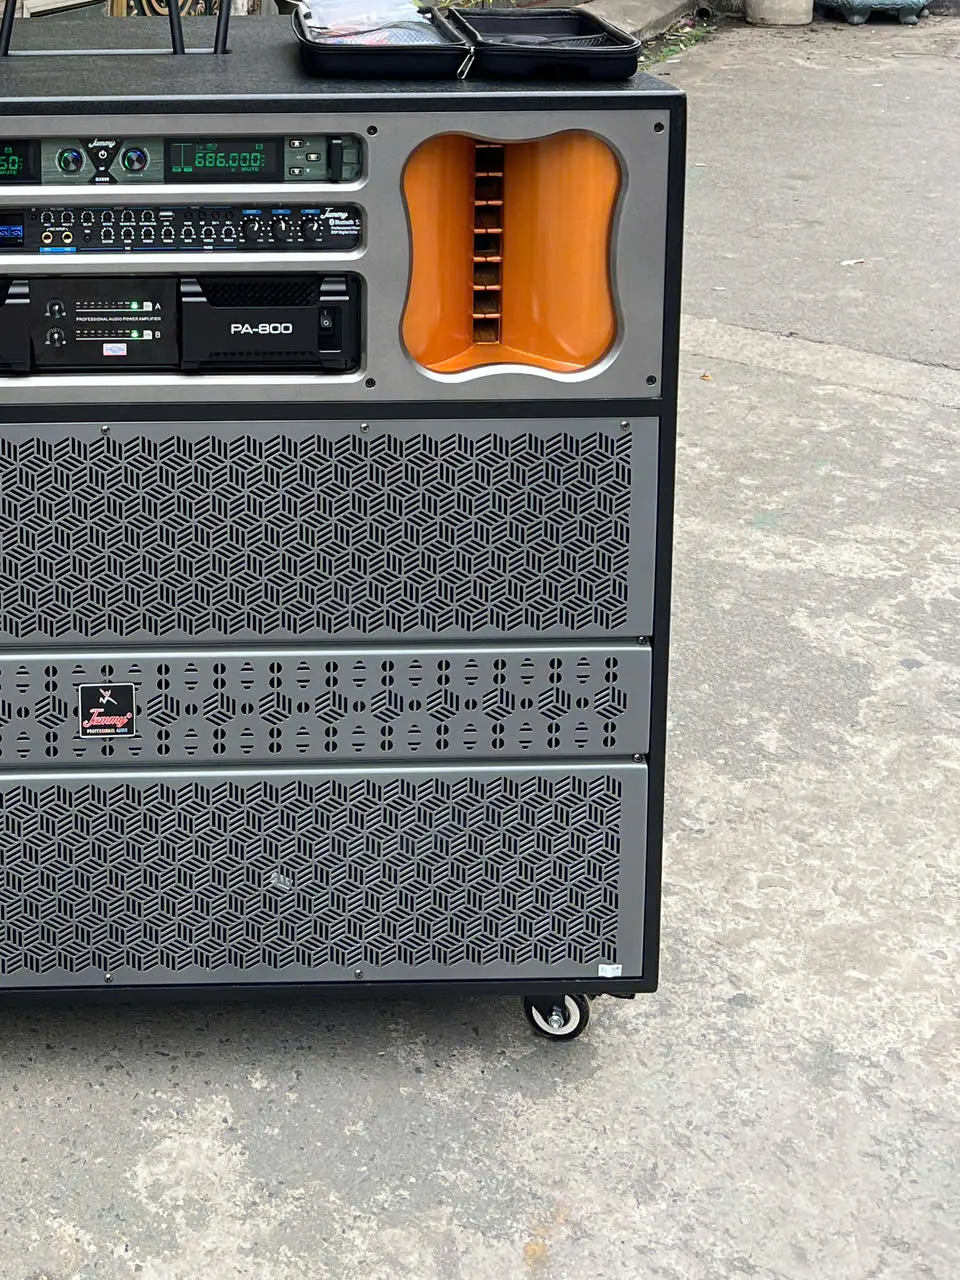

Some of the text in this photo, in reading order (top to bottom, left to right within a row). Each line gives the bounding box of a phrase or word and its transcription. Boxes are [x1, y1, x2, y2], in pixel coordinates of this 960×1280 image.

[195, 153, 261, 167] 686.000
[230, 323, 292, 334] PA-800
[82, 708, 128, 728] Jammy
